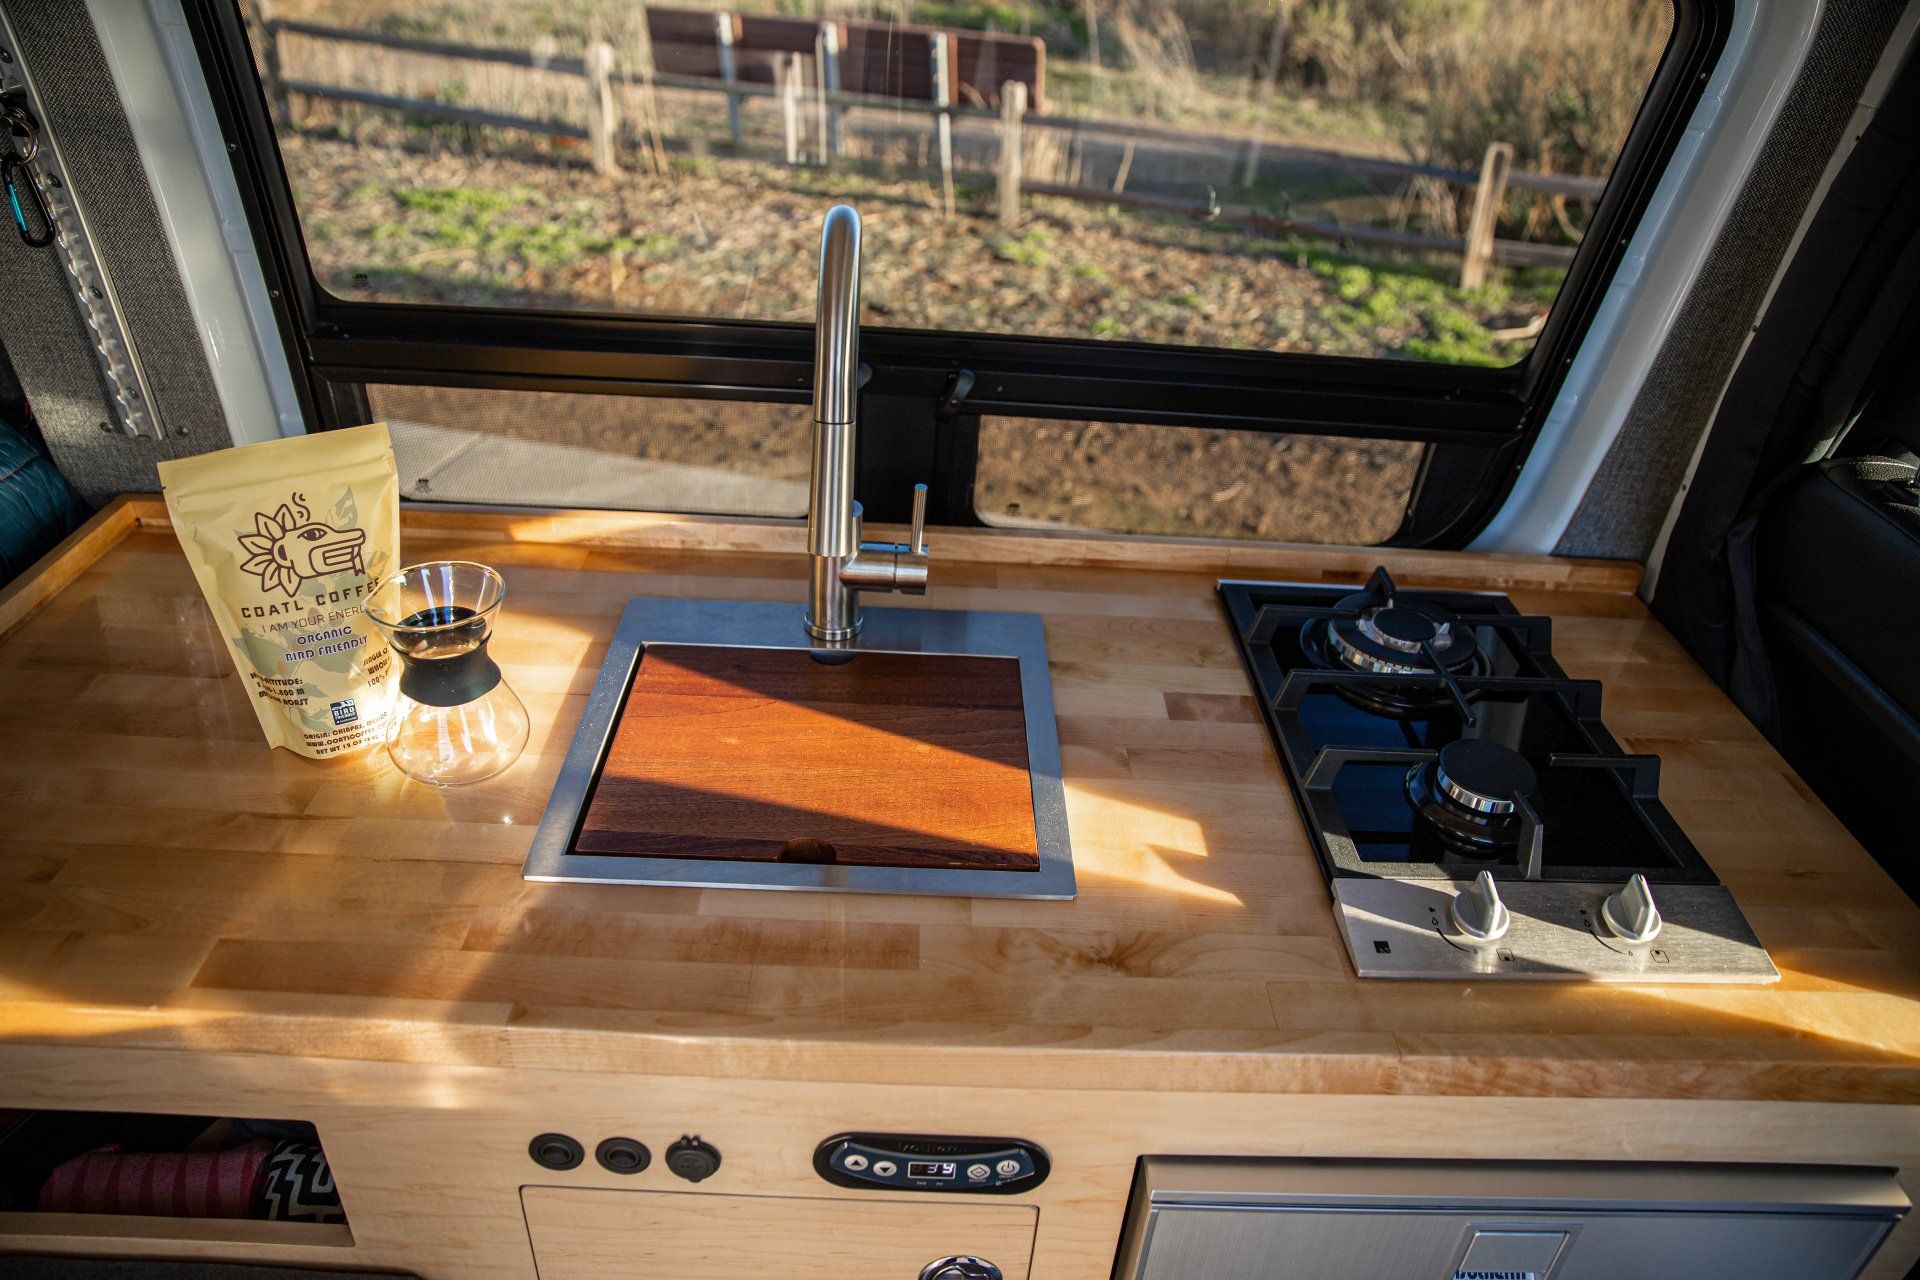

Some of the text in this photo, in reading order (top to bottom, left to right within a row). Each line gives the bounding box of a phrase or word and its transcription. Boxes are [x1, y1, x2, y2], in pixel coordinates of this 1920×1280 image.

[241, 600, 304, 618] COATL
[262, 625, 267, 634] I
[269, 622, 289, 633] AM
[291, 614, 325, 628] YOUR
[297, 626, 352, 645] ORGANIC
[285, 635, 368, 663] BIRD FRIENDLY
[283, 698, 309, 706] ROAST
[333, 706, 355, 717] BIRD
